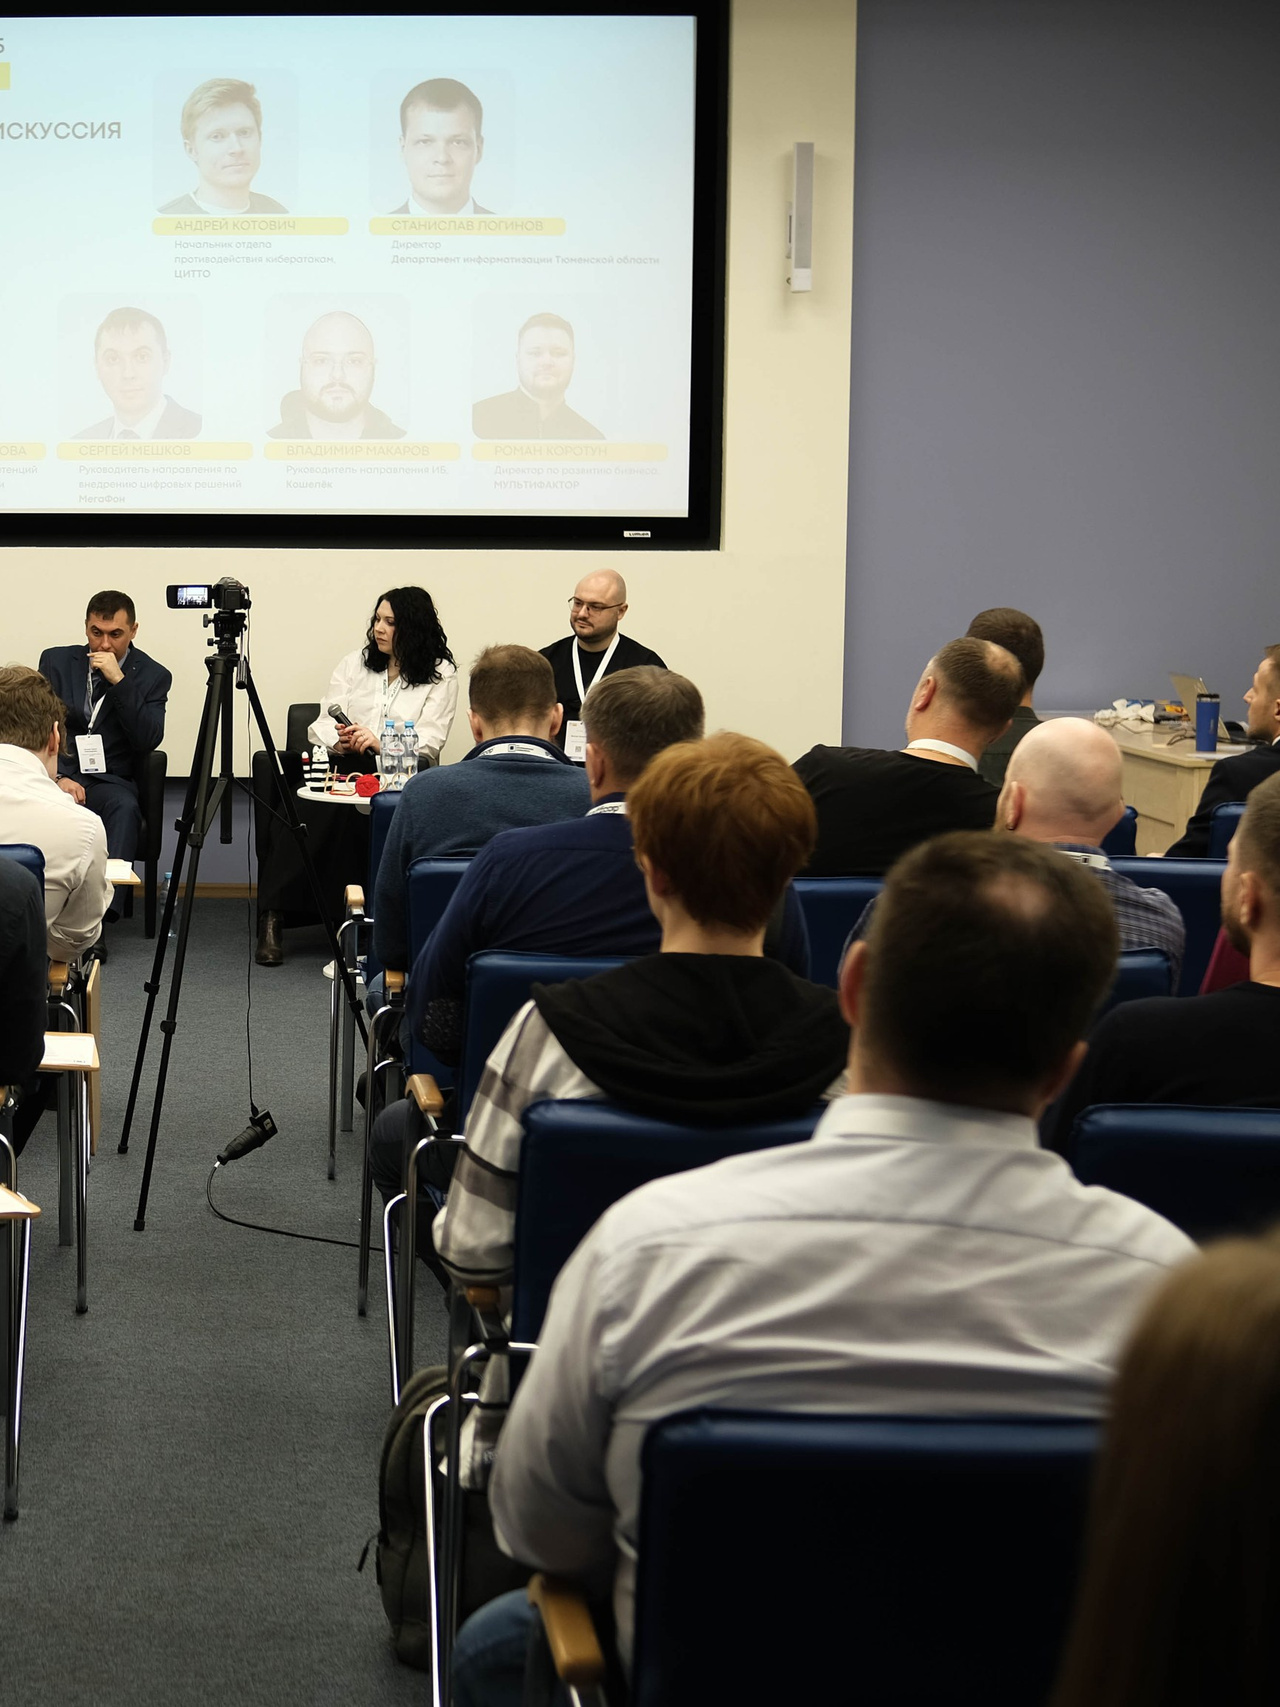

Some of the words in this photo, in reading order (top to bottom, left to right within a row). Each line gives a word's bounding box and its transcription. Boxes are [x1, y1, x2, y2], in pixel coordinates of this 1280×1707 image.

[174, 218, 229, 232] АНДРЕЙ
[232, 219, 296, 231] КОТОВИЧ
[391, 220, 474, 232] СТАНИСЛАВ
[477, 220, 544, 232] ЛОГИНОВ
[174, 240, 233, 249] Начальник
[235, 241, 272, 250] отдела
[391, 240, 442, 251] Директор
[174, 254, 263, 265] противодействия
[265, 254, 336, 265] кибератакам,
[391, 254, 461, 265] Департамент
[463, 254, 553, 265] информатизации
[555, 254, 614, 264] Тюменской
[616, 255, 660, 264] области
[174, 269, 211, 279] ЦИТТО
[78, 443, 129, 457] СЕРГЕЙ
[131, 445, 192, 457] МЕШКОВ
[286, 445, 364, 457] ВЛАДИМИР
[366, 445, 430, 457] МАКАРОВ
[494, 445, 542, 457] РОМАН
[78, 465, 151, 476] Руководитель
[152, 466, 222, 476] направления
[224, 466, 238, 474] по
[286, 465, 358, 476] Руководитель
[359, 466, 429, 476] направления
[494, 465, 544, 476] Директор
[547, 467, 559, 475] по
[562, 466, 612, 476] развитию
[78, 480, 138, 490] внедрению
[139, 480, 192, 490] цифровых
[194, 479, 243, 490] решений
[286, 480, 333, 489] Кошелёк
[494, 480, 580, 490] МУЛЬТИФАКТОР
[78, 494, 126, 504] МегаФон
